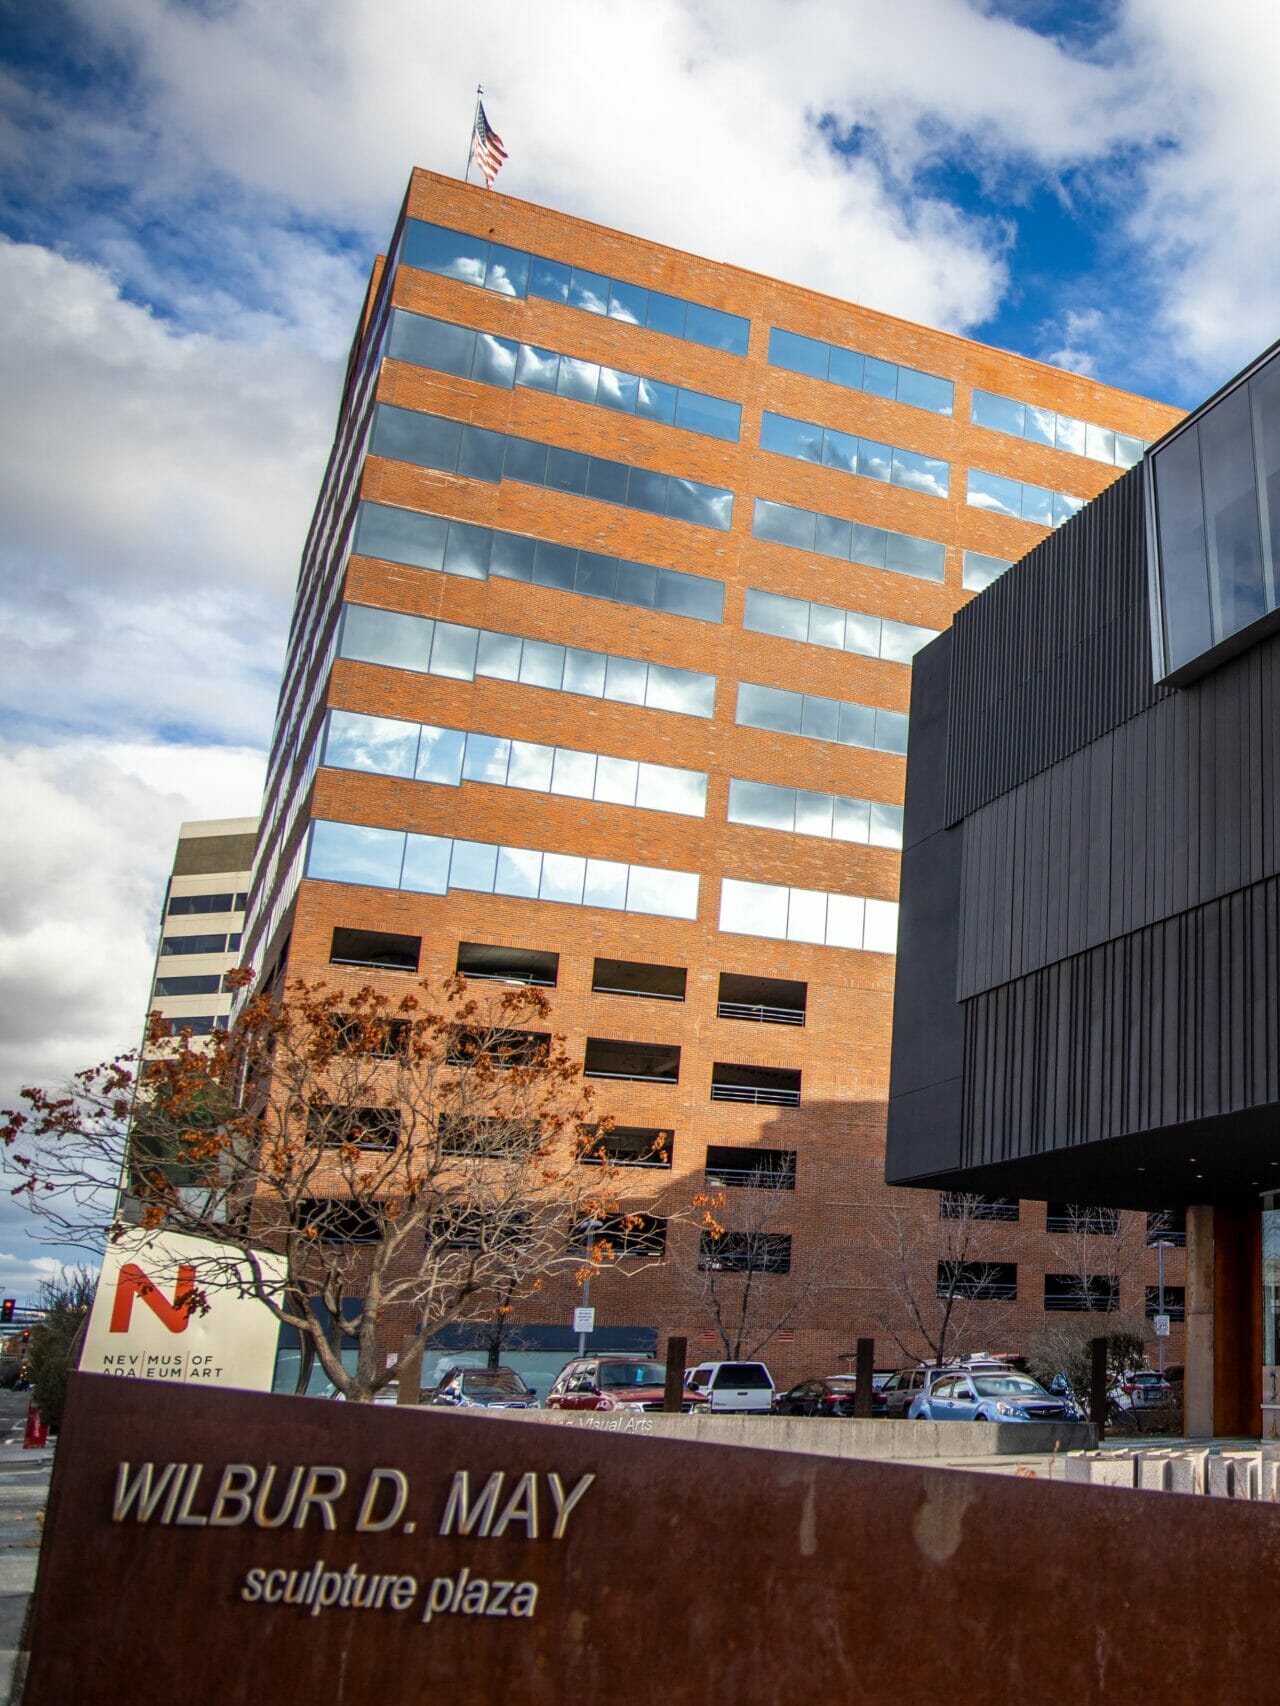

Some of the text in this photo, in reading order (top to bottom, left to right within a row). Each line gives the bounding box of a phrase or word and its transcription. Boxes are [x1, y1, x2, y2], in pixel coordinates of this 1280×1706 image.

[109, 1262, 198, 1334] N
[103, 1355, 213, 1365] NEV MUS OF
[103, 1367, 223, 1378] ADA EUM ART
[579, 1417, 622, 1431] Visual
[625, 1417, 654, 1431] Arts
[112, 1462, 595, 1539] WILBUR D. MAY
[241, 1560, 539, 1622] sculpture plaza
